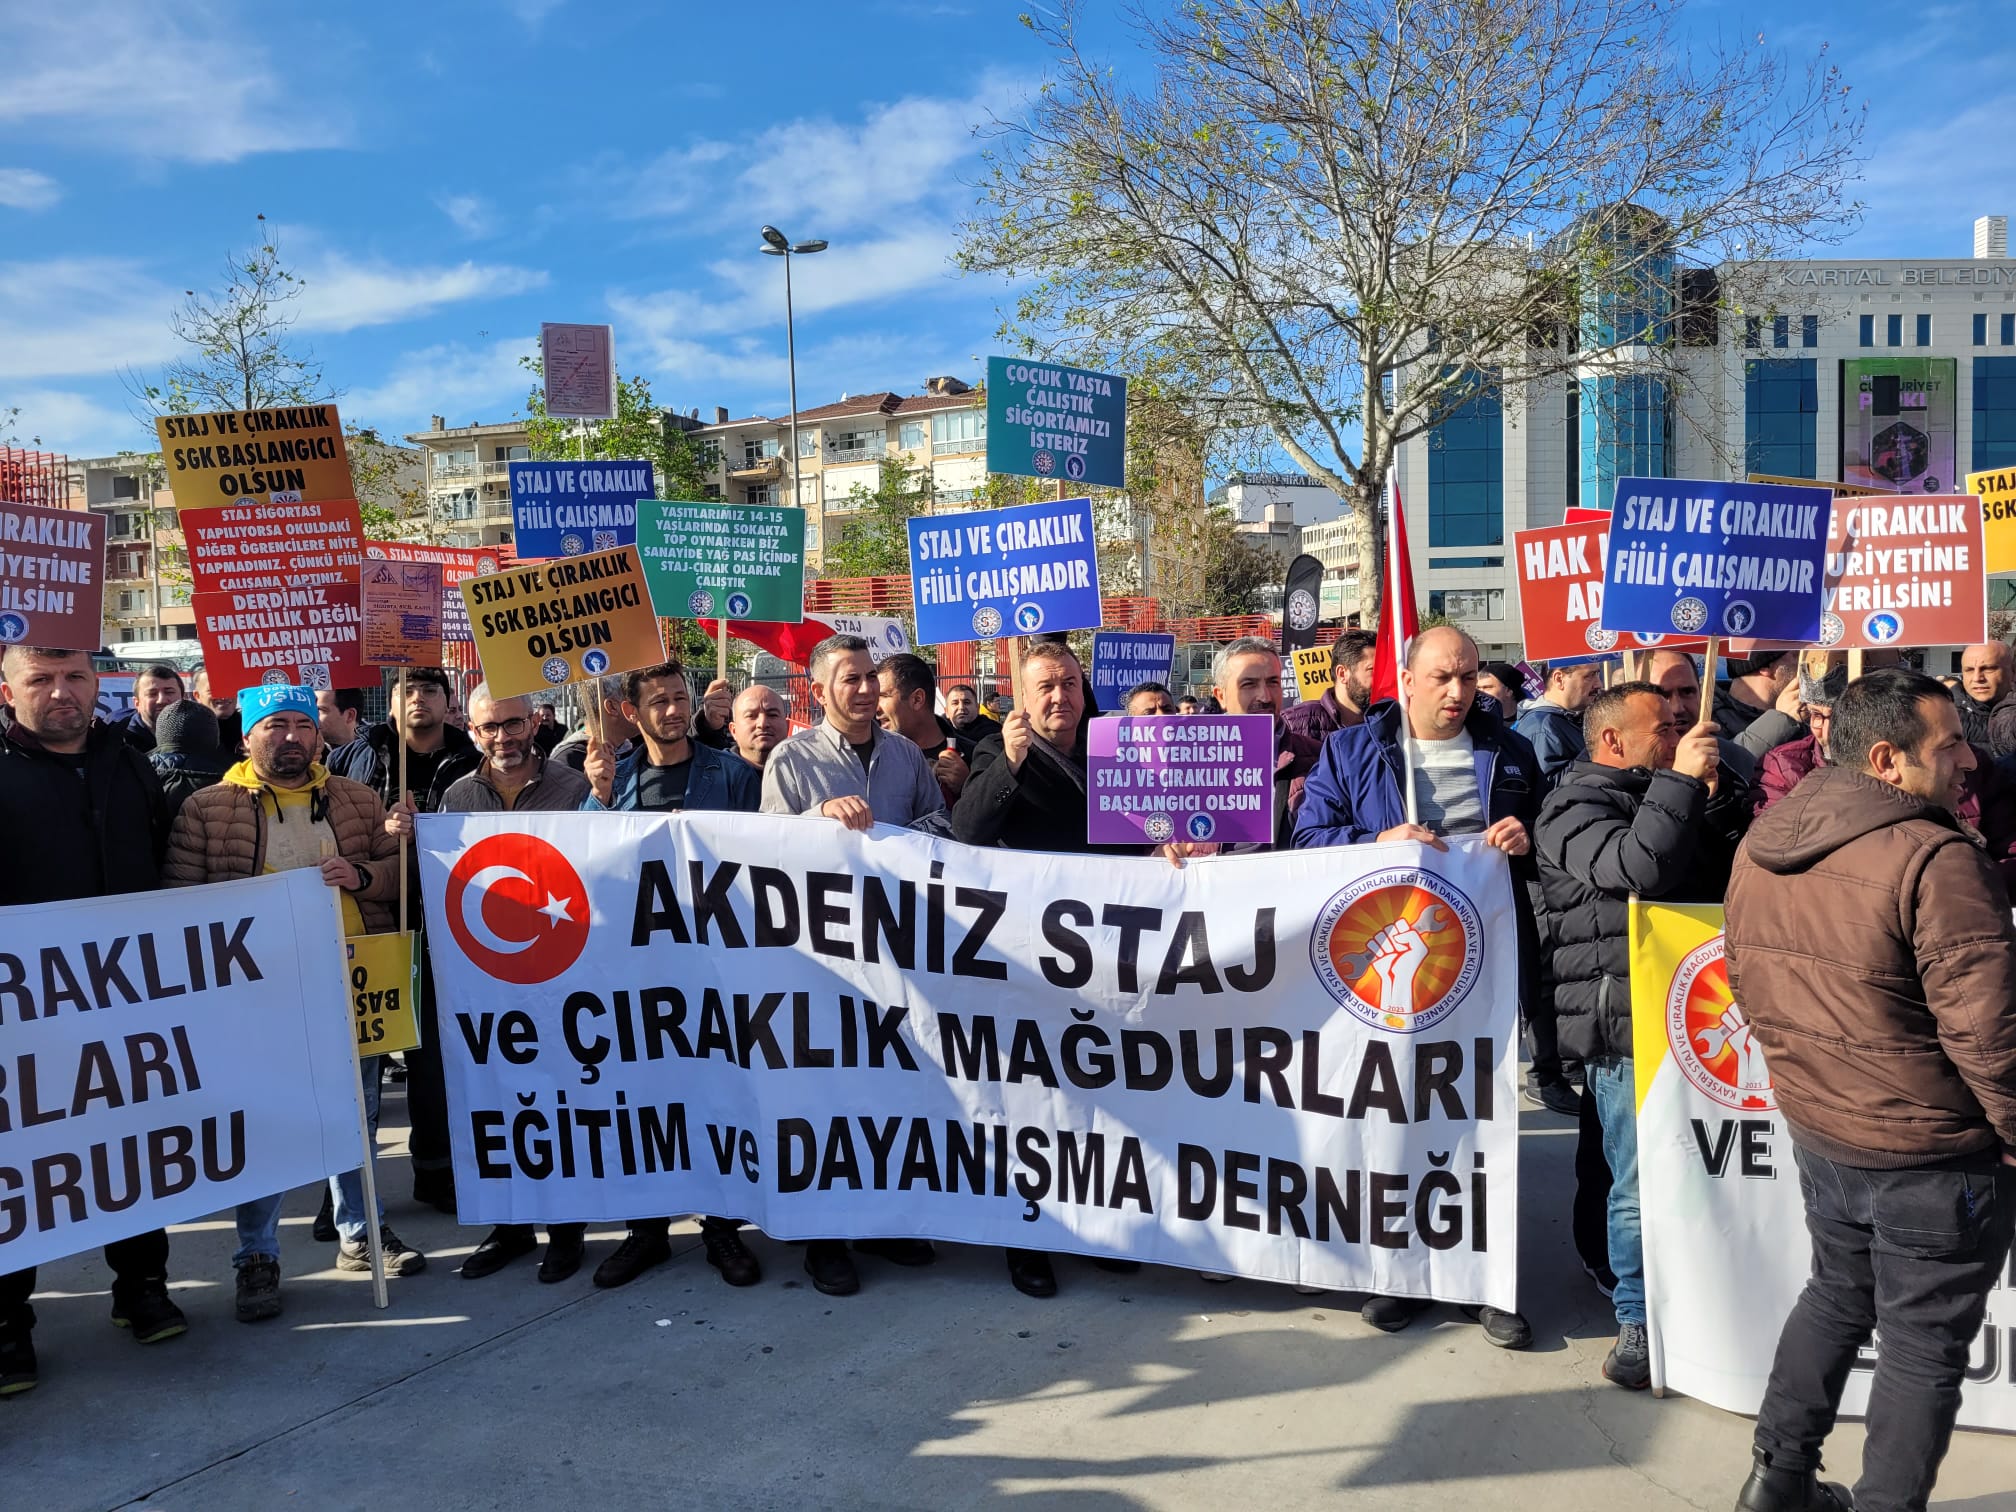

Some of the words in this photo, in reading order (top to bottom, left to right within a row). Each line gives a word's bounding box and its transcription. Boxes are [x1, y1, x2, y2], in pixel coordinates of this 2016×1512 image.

[1781, 268, 1891, 287] KARTAL
[1067, 373, 1111, 398] YAŞTA
[1026, 389, 1094, 415] ÇALIŞTIK
[165, 416, 209, 438] STAJ
[213, 414, 239, 434] VE
[243, 407, 329, 438] ÇIRAKLIK
[1006, 404, 1110, 438] SİGORTAMIZI
[1030, 427, 1089, 455] İSTERİZ
[174, 446, 216, 471] SGK
[216, 437, 336, 472] BAŞLANGICI
[219, 469, 306, 496] OLSUN
[516, 470, 552, 494] STAJ
[555, 470, 575, 493] VE
[579, 469, 648, 499] ÇIRAKLIK
[1977, 473, 2016, 495] STAJ
[221, 508, 251, 522] STAJ
[518, 500, 552, 529] FİİLİ
[555, 503, 636, 535] ÇALIŞMAD
[750, 511, 783, 523] 14-15
[1623, 495, 1679, 532] STAJ
[1685, 497, 1713, 534] VE
[1720, 499, 1819, 546] ÇIRAKLIK
[1982, 499, 2016, 522] SGK
[197, 524, 283, 540] YAPILIYORSA
[286, 518, 350, 534] OKULDAKİ
[656, 520, 729, 535] YAŞLARINDA
[734, 524, 788, 536] SOKAKTA
[919, 528, 962, 560] STAJ
[966, 525, 991, 555] VE
[996, 514, 1084, 560] ÇIRAKLIK
[1846, 503, 1967, 547] ÇIRAKLIK
[196, 542, 236, 557] DİĞER
[329, 535, 358, 550] NİYE
[664, 534, 687, 544] TOP
[691, 535, 755, 549] OYNARKEN
[759, 536, 779, 550] BİZ
[196, 559, 286, 575] YAPMADINIZ.
[289, 553, 333, 572] ÇÜNKÜ
[389, 548, 412, 560] STAJ
[457, 553, 474, 567] SGK
[644, 546, 702, 559] SANAYİDE
[706, 547, 730, 561] YAĞ
[734, 550, 755, 561] PAS
[759, 549, 798, 565] İÇİNDE
[1524, 535, 1591, 581] HAK
[472, 577, 515, 605] STAJ
[518, 571, 543, 595] VE
[547, 552, 632, 594] ÇIRAKLIK
[660, 561, 728, 576] STAJ-ÇIRAK
[733, 564, 781, 577] OLARAK
[1613, 540, 1667, 586] FİİLİ
[1672, 552, 1814, 600] ÇALIŞMADIR
[696, 576, 746, 590] ÇALIŞTIK
[920, 566, 962, 605] FİİLİ
[966, 559, 1090, 609] ÇALIŞMADIR
[1823, 575, 1952, 612] VERİLSİN!
[232, 585, 328, 611] DERDİMİZ
[482, 608, 524, 638] SGK
[523, 583, 640, 630] BAŞLANGICI
[206, 607, 304, 632] EMEKLİLİK
[309, 603, 361, 626] DEĞİL
[834, 620, 862, 632] STAJ
[217, 625, 357, 651] HAKLARIMIZIN
[527, 620, 612, 658] OLSUN
[241, 643, 341, 668] İADESİDİR.
[1098, 641, 1118, 660] STAJ
[1120, 642, 1132, 660] VE
[1133, 642, 1170, 665] ÇIRAKLIK
[1298, 650, 1325, 665] STAJ
[1096, 664, 1115, 686] FİİLİ
[1303, 668, 1329, 686] SGK
[1119, 726, 1156, 742] HAK
[1162, 725, 1242, 742] GASBINA
[1116, 746, 1151, 762] SON
[1157, 742, 1243, 762] VERİLSİN!
[1096, 768, 1131, 788] STAJ
[1136, 768, 1154, 787] VE
[1159, 768, 1229, 792] ÇIRAKLIK
[1234, 768, 1263, 787] SGK
[1100, 795, 1200, 816] BAŞLANGICI
[1206, 794, 1261, 810] OLSUN
[1330, 874, 1397, 916] MAĞDURLARI
[1400, 872, 1438, 892] EĞİTİM
[1438, 886, 1477, 940] DAYANIŞMA
[631, 859, 1008, 981] AKDENİZ
[1039, 899, 1277, 996] STAJ
[1317, 915, 1336, 951] ÇIRAKLIK
[1468, 940, 1477, 954] VE
[0, 916, 264, 1026] RAKLIK
[1319, 954, 1329, 967] VE
[1323, 965, 1340, 988] STAJ
[1452, 957, 1477, 994] KÜLTÜR
[1336, 987, 1379, 1020] AKDENİZ
[1387, 1005, 1405, 1013] 2023
[1413, 994, 1456, 1027] DERNEĞİ
[1672, 979, 1688, 1030] ÇIRAKLIK
[1675, 1034, 1687, 1048] VE
[456, 1009, 539, 1064] ve
[562, 987, 919, 1084] ÇIRAKLIK
[937, 1008, 1494, 1124] MAĞDURLARI
[1681, 1050, 1700, 1073] STAJ
[0, 1025, 201, 1134] LARI
[1698, 1071, 1737, 1101] KAYSERİ
[1690, 1118, 1777, 1180] VE
[0, 1110, 247, 1245] GRUBU
[471, 1090, 691, 1180] EĞİTİM
[706, 1124, 760, 1184] ve
[777, 1115, 1153, 1222] DAYANIŞMA
[1177, 1142, 1488, 1253] DERNEĞİ
